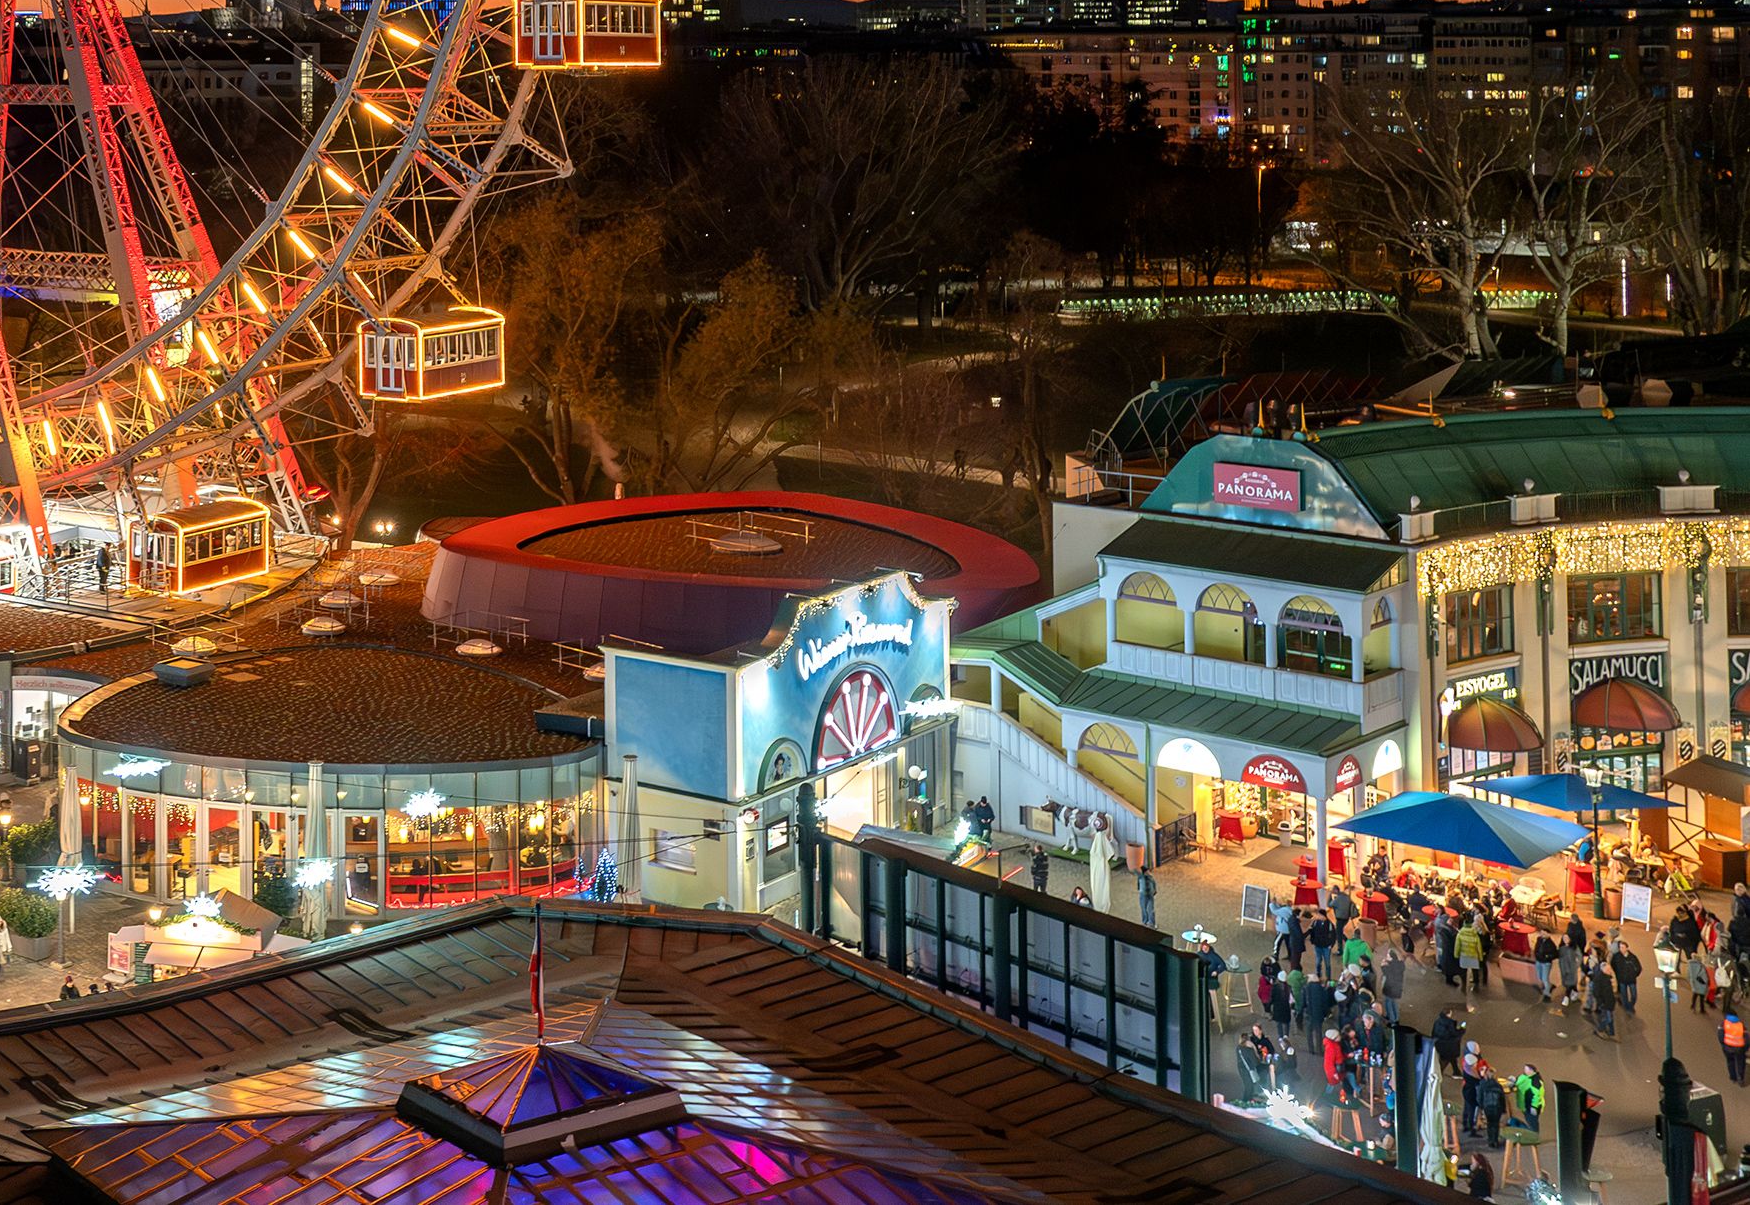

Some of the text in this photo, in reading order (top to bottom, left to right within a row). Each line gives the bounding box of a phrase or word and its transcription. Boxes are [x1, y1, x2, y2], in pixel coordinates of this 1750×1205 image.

[1218, 482, 1293, 502] PANORAMA
[1571, 654, 1663, 695] SALAMUCCI
[1732, 651, 1750, 684] S
[1455, 672, 1508, 698] EISVOGEL
[1248, 765, 1299, 783] PANORAMA
